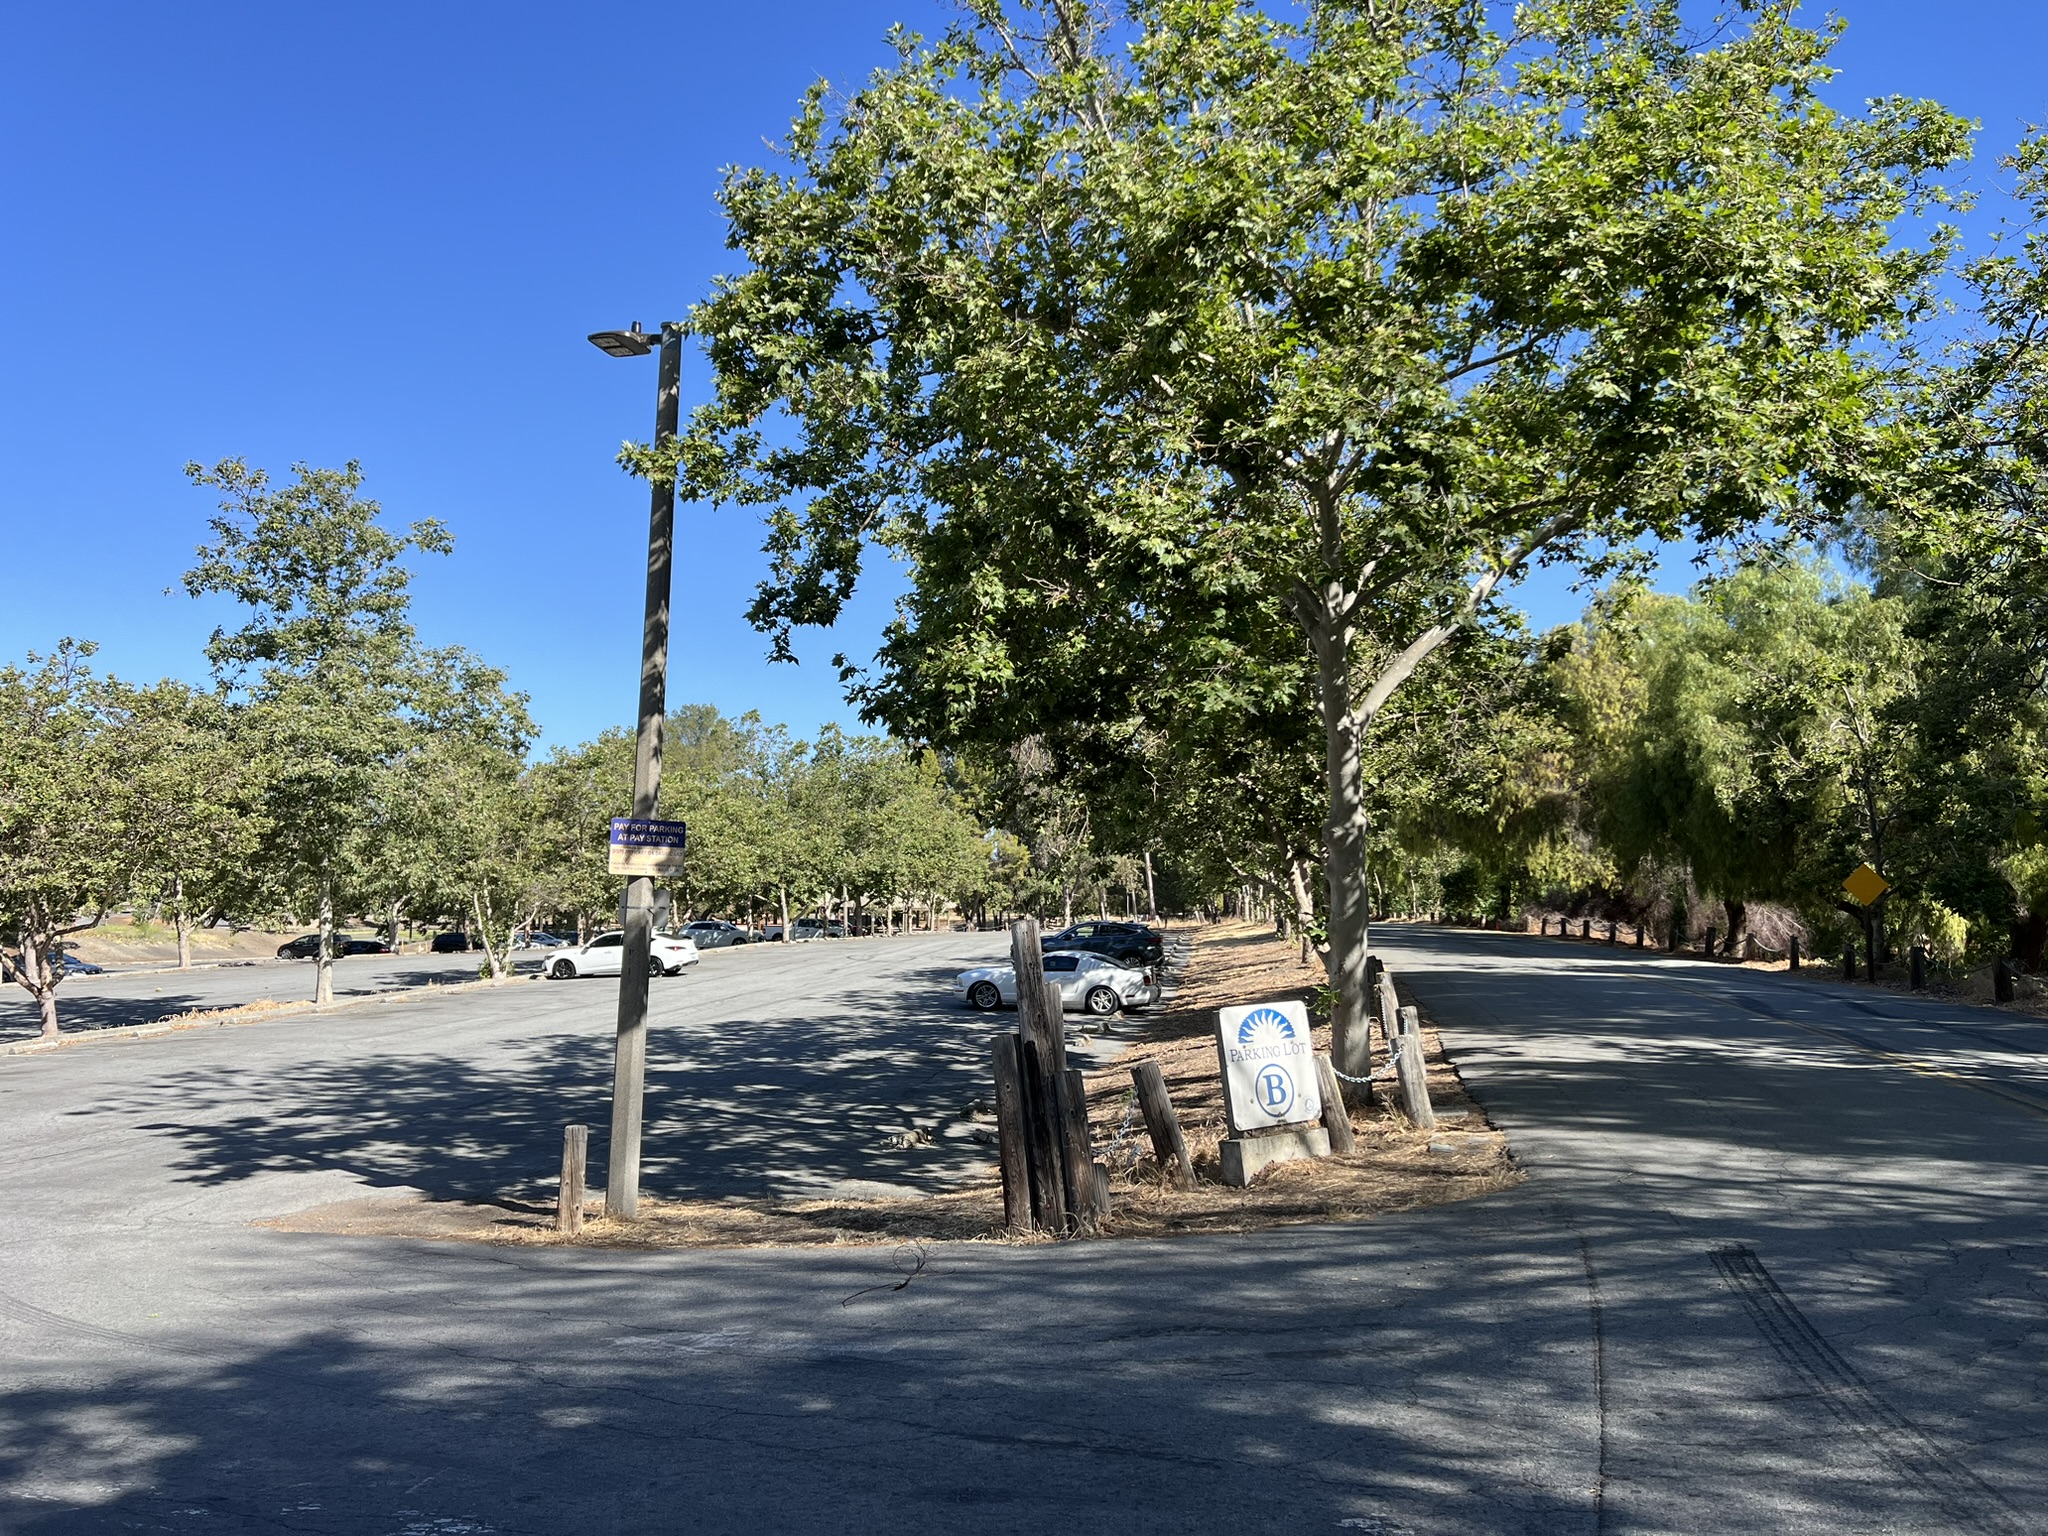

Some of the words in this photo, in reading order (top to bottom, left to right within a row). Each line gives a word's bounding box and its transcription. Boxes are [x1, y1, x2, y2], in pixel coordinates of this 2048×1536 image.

[614, 823, 629, 831] PAY
[631, 824, 647, 832] FOR
[649, 825, 683, 834] PARKING
[617, 833, 628, 841] AT
[630, 834, 645, 842] PAY
[646, 835, 679, 844] STATION
[1230, 1046, 1280, 1062] PARKING
[1284, 1043, 1306, 1056] LOT
[1262, 1074, 1287, 1106] B
